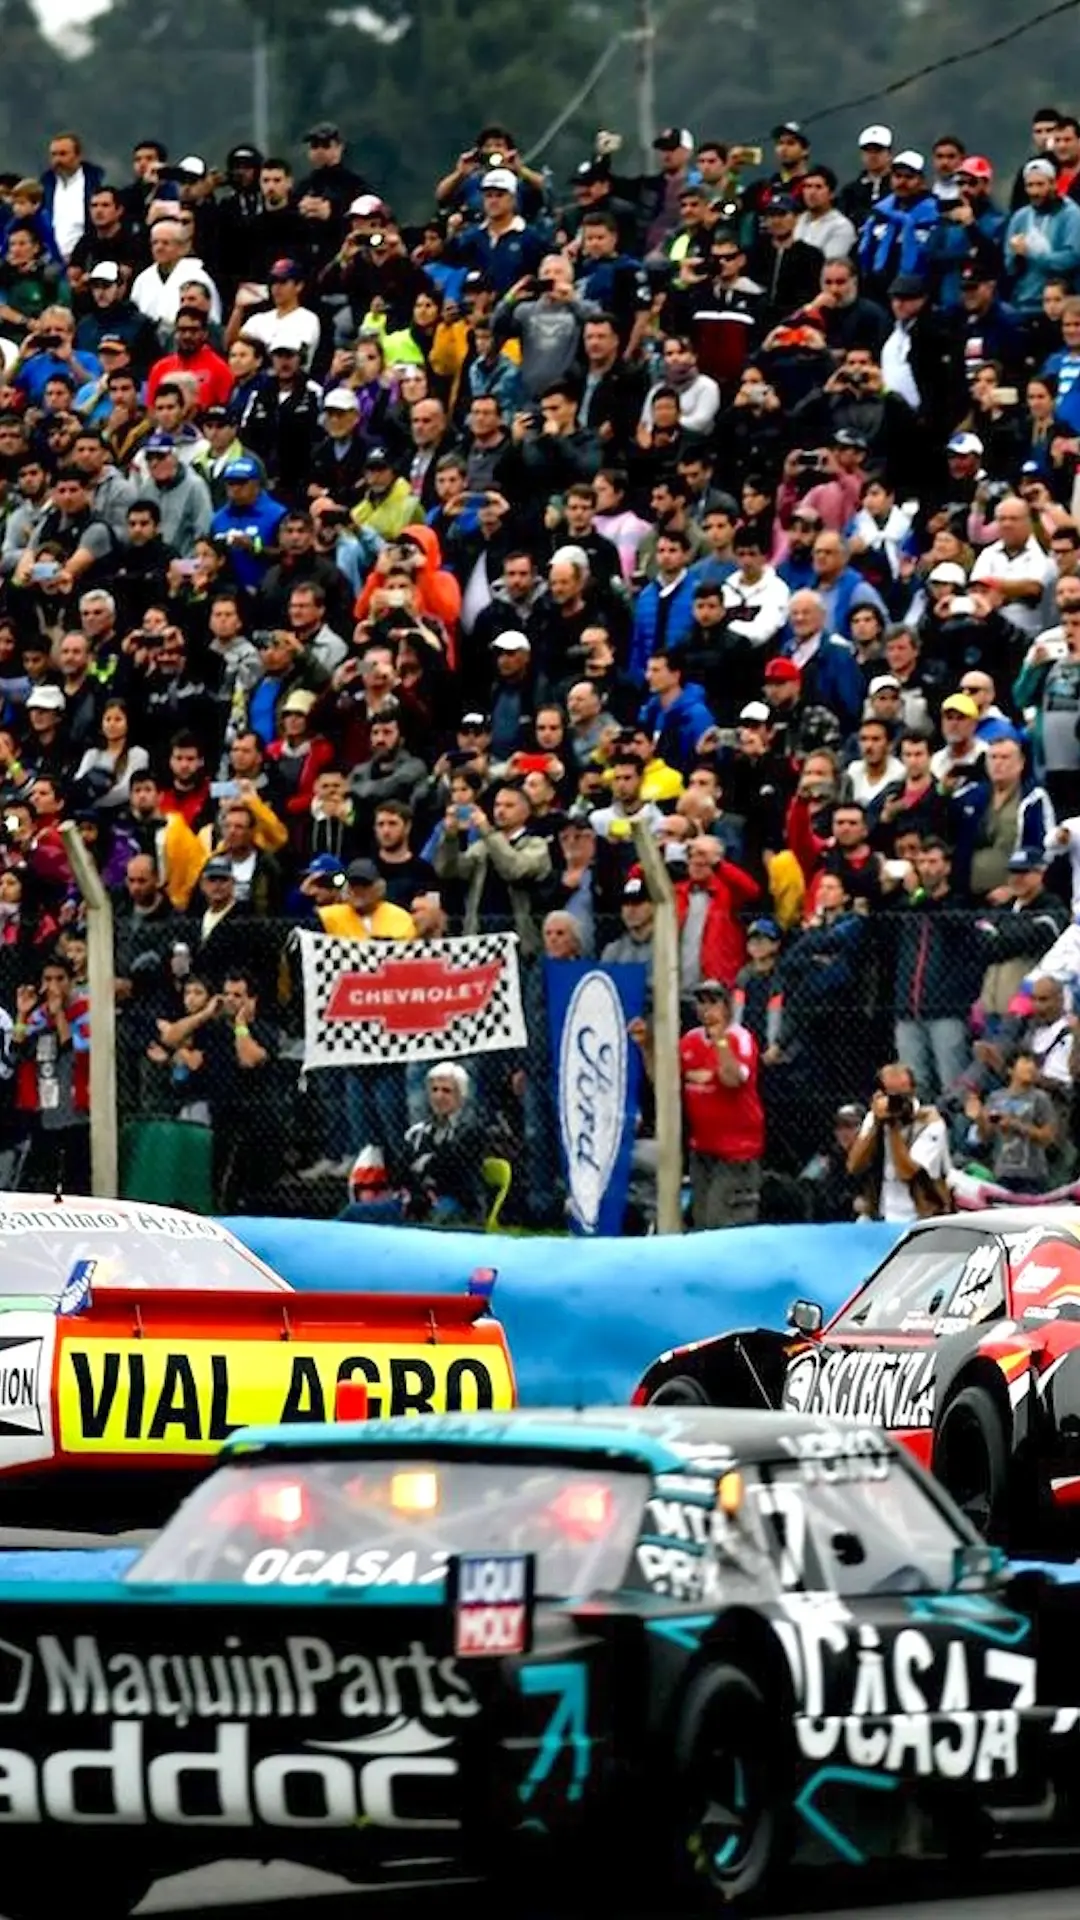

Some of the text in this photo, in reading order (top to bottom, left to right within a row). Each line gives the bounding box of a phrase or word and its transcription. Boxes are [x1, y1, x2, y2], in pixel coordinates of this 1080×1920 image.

[348, 981, 487, 1006] CHEVROLET
[576, 1025, 614, 1172] Ford
[70, 1351, 249, 1441] VIAL
[811, 1351, 938, 1428] SCIENZA
